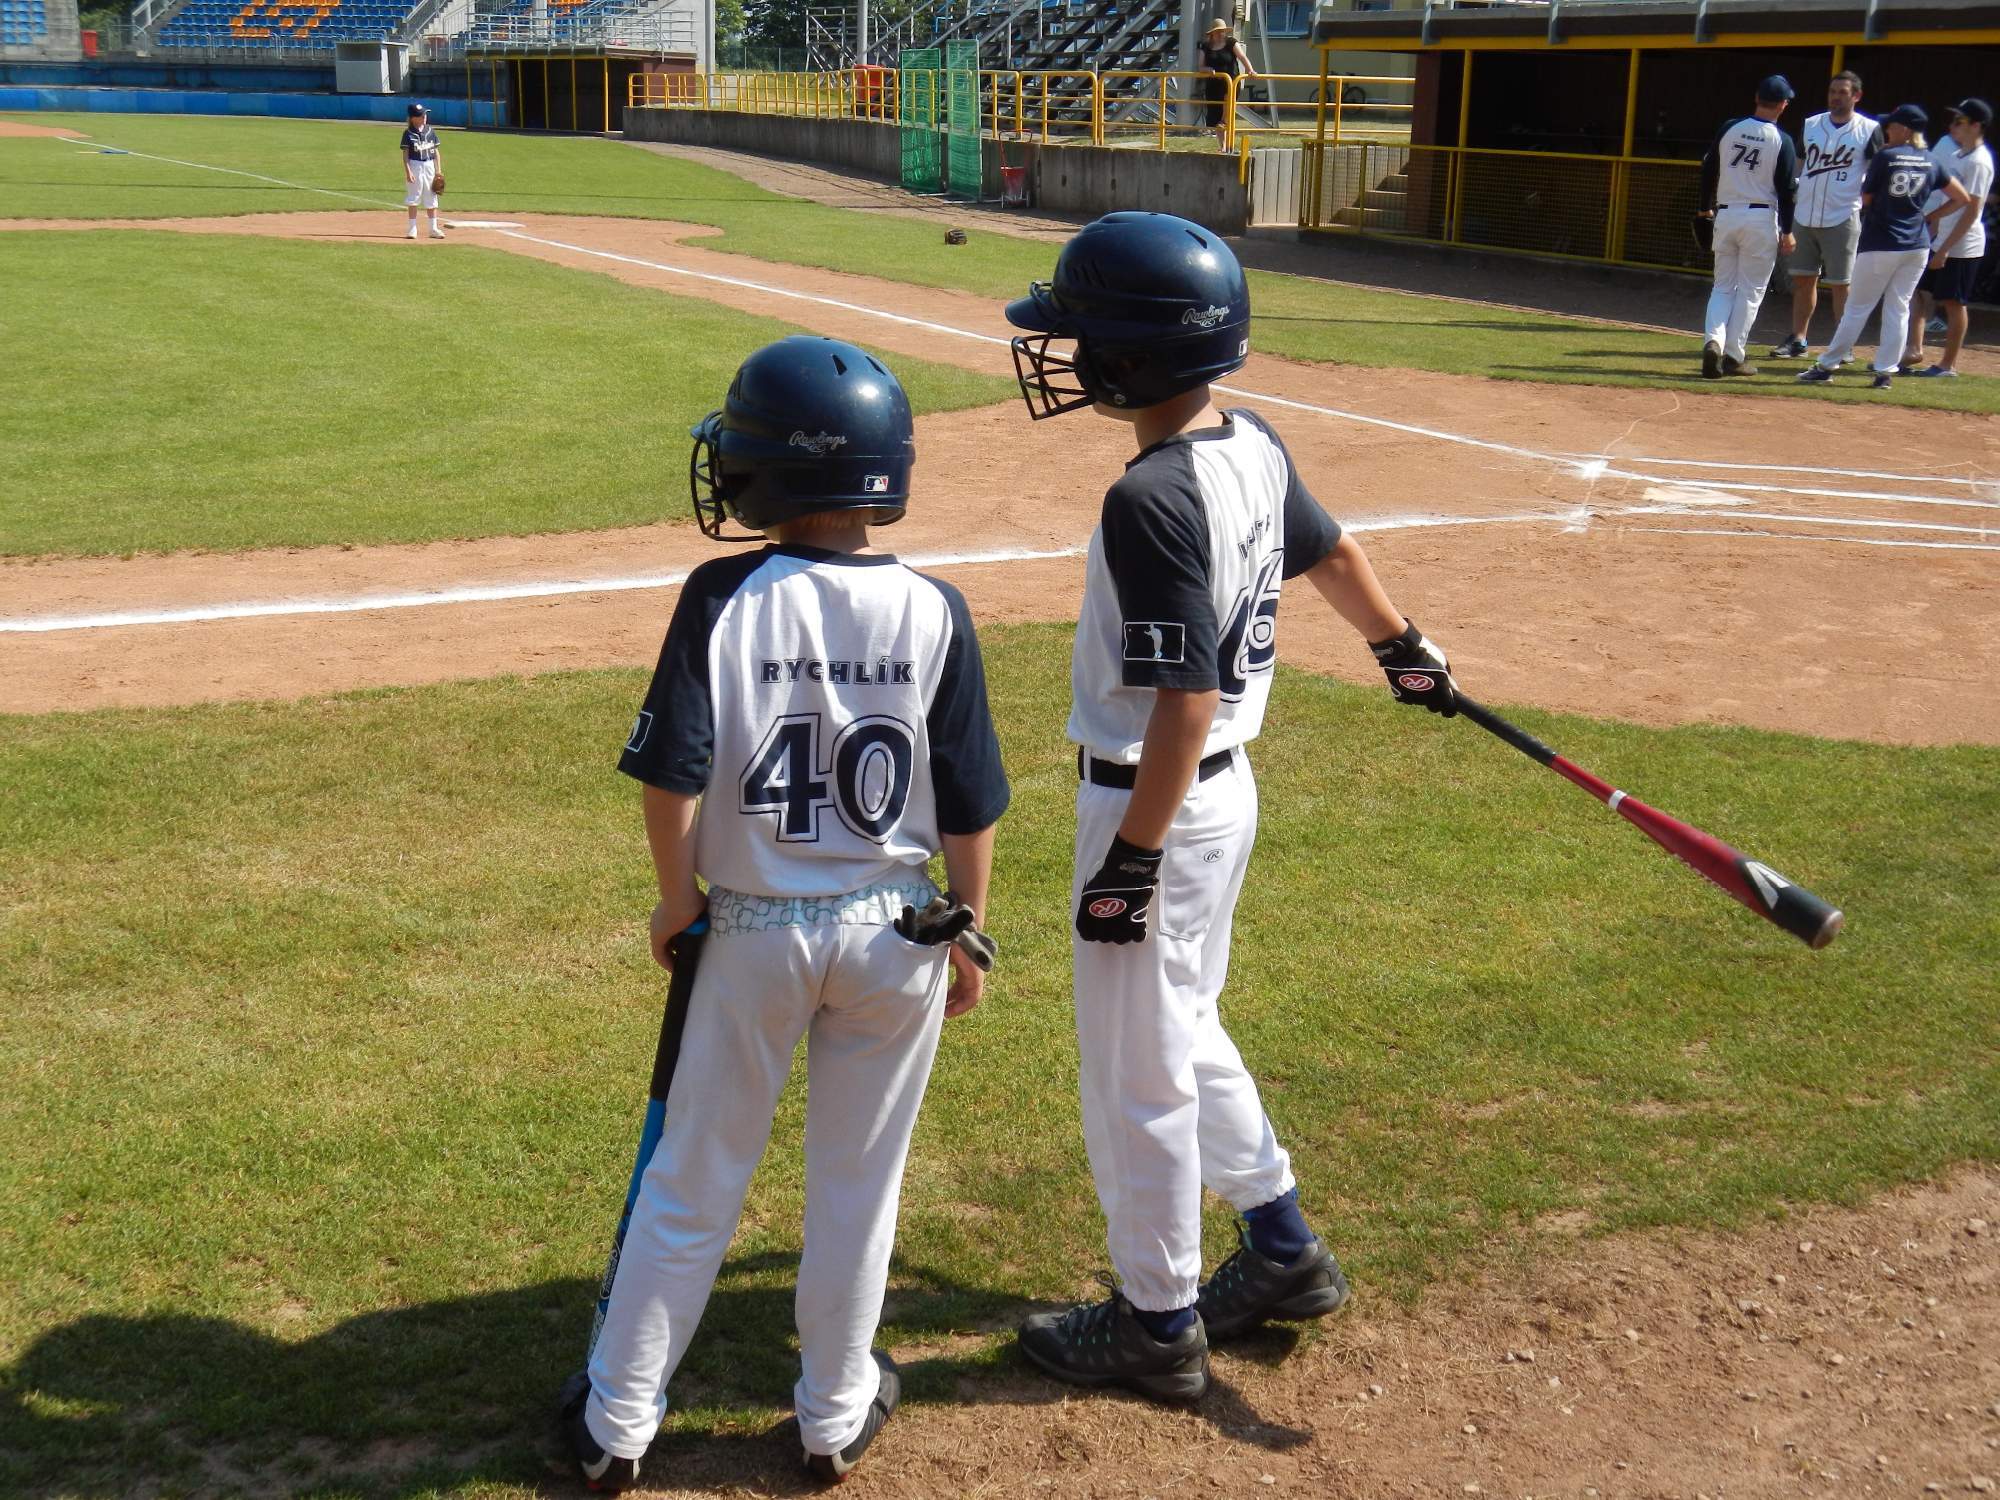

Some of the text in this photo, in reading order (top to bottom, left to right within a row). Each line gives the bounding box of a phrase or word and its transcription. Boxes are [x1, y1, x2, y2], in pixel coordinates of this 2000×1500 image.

[1730, 143, 1760, 171] 74
[1836, 171, 1847, 181] 13
[1890, 172, 1926, 197] 87
[1182, 304, 1230, 326] Rawlings
[789, 430, 847, 451] Rawlings
[761, 656, 914, 684] RYCHLÍK
[739, 713, 915, 844] 40
